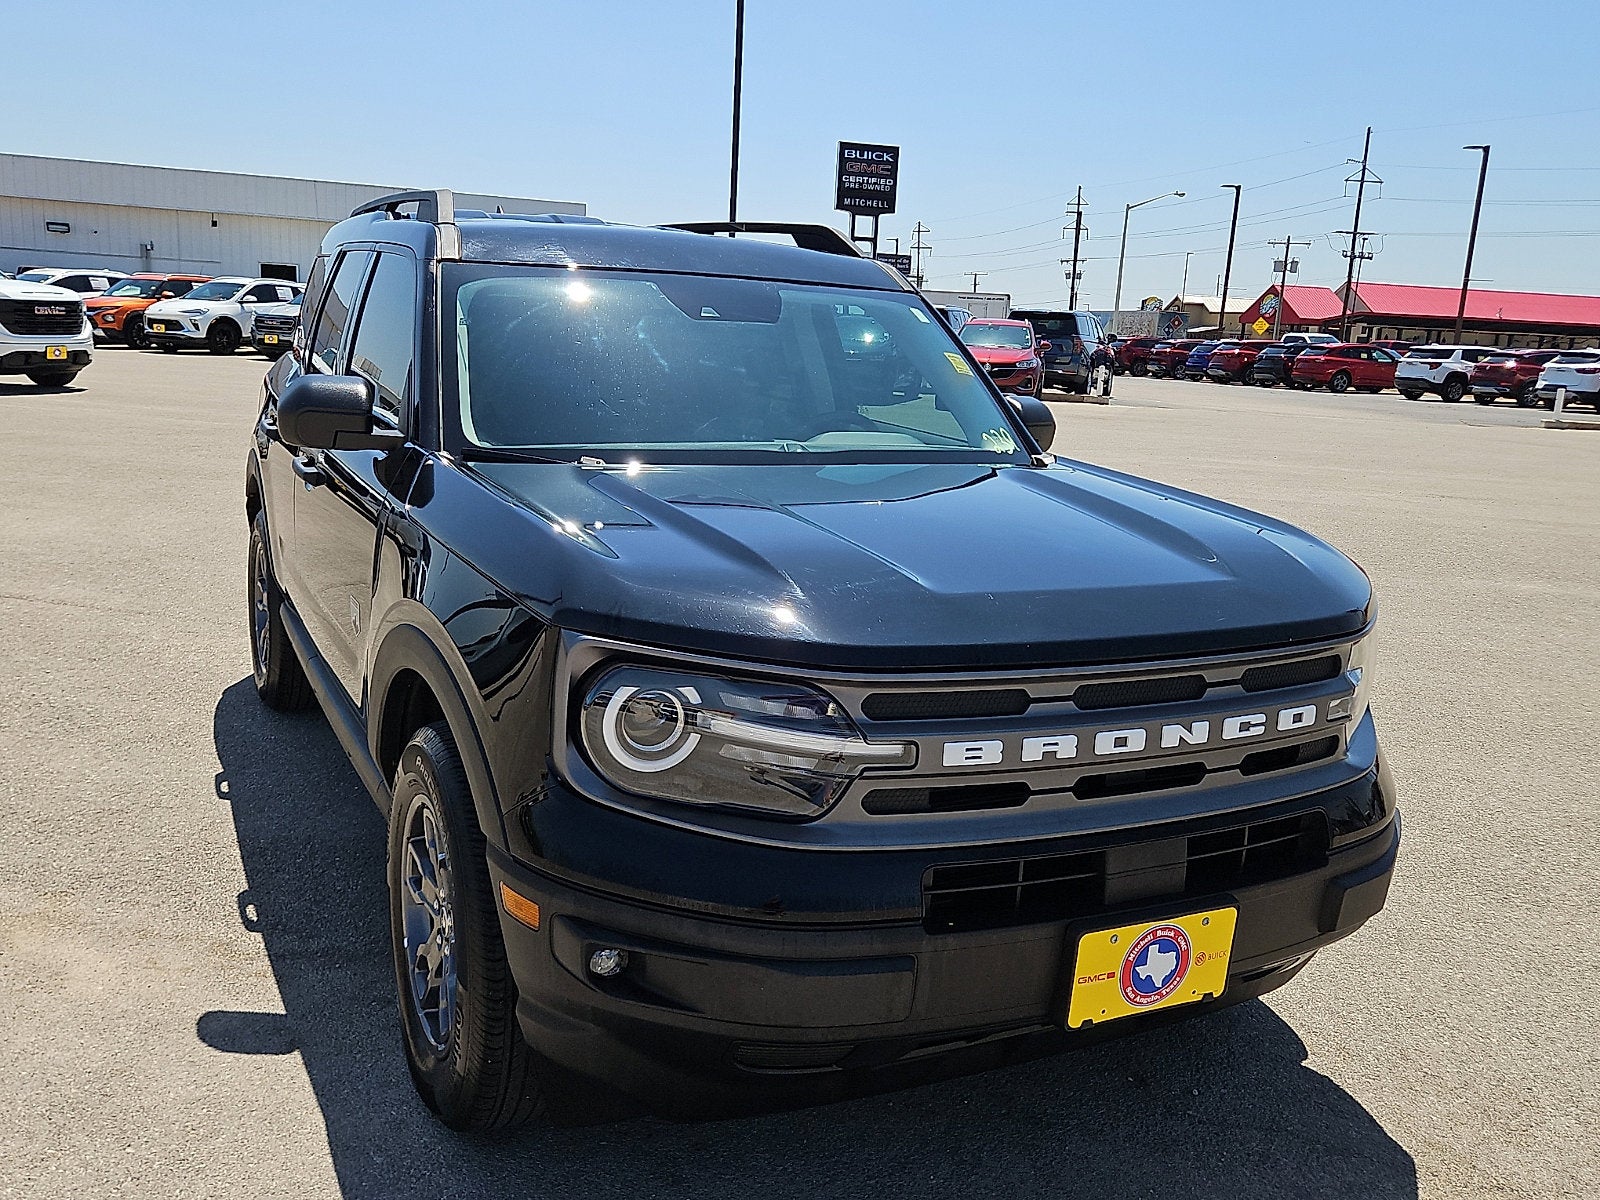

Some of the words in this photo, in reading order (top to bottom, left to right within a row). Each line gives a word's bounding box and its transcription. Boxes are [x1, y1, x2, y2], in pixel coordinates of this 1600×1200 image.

[844, 150, 894, 161] BUICK
[846, 161, 892, 175] GMC
[842, 175, 894, 186] CERTIFIED
[844, 182, 891, 192] PRE-OWNED
[843, 197, 889, 208] MITCHELL
[942, 704, 1317, 768] BRONCO
[1128, 933, 1154, 962] Mitchell
[1156, 929, 1176, 937] Buick
[1177, 935, 1188, 952] GMC
[1207, 950, 1227, 961] BUICK
[1077, 973, 1108, 985] GMC
[1125, 986, 1136, 999] San
[1161, 976, 1181, 996] Texas
